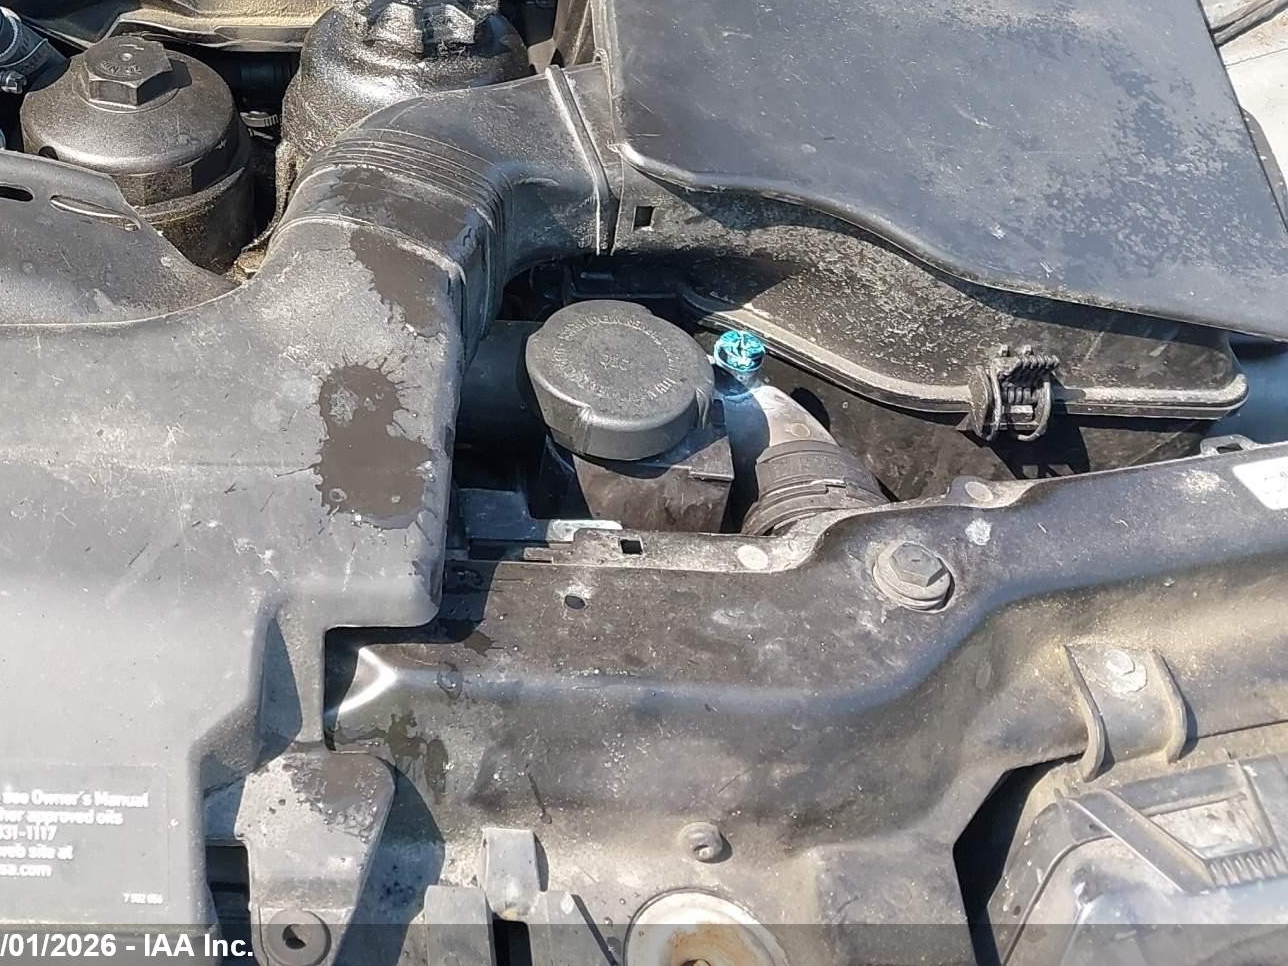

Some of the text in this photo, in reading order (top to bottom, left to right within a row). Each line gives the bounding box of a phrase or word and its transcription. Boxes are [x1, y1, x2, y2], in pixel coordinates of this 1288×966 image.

[3, 791, 29, 804] see
[31, 789, 92, 806] Owner's
[95, 791, 149, 807] Manual
[26, 809, 94, 826] approved
[96, 810, 123, 825] oils
[29, 844, 55, 859] site
[58, 845, 73, 860] at
